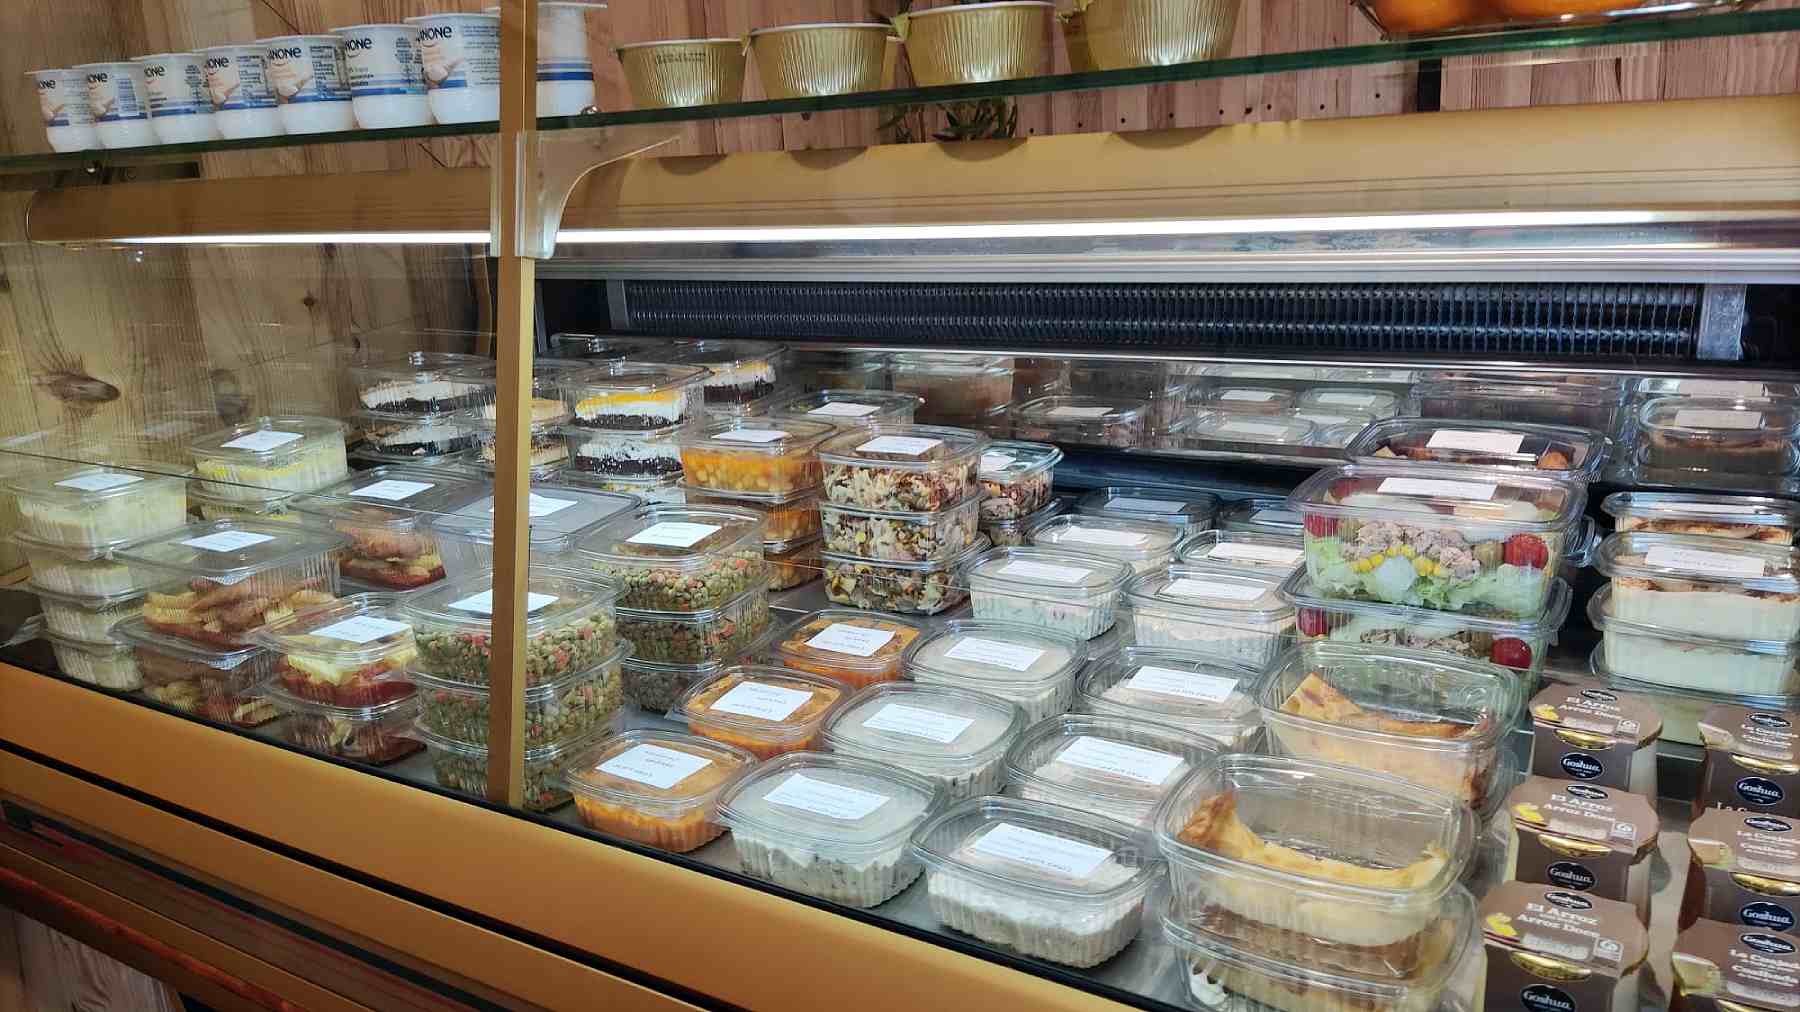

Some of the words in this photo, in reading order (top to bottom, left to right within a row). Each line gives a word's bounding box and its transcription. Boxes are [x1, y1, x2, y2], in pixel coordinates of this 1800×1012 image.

[1563, 758, 1600, 772] Goshua
[1739, 782, 1781, 798] Goshua
[1544, 803, 1580, 815] Arroz
[1550, 867, 1592, 883] Goshua
[1517, 914, 1560, 928] Arroz
[1547, 907, 1598, 925] Arroz
[1743, 908, 1792, 924] Goshua
[1523, 990, 1572, 1010] Goshua
